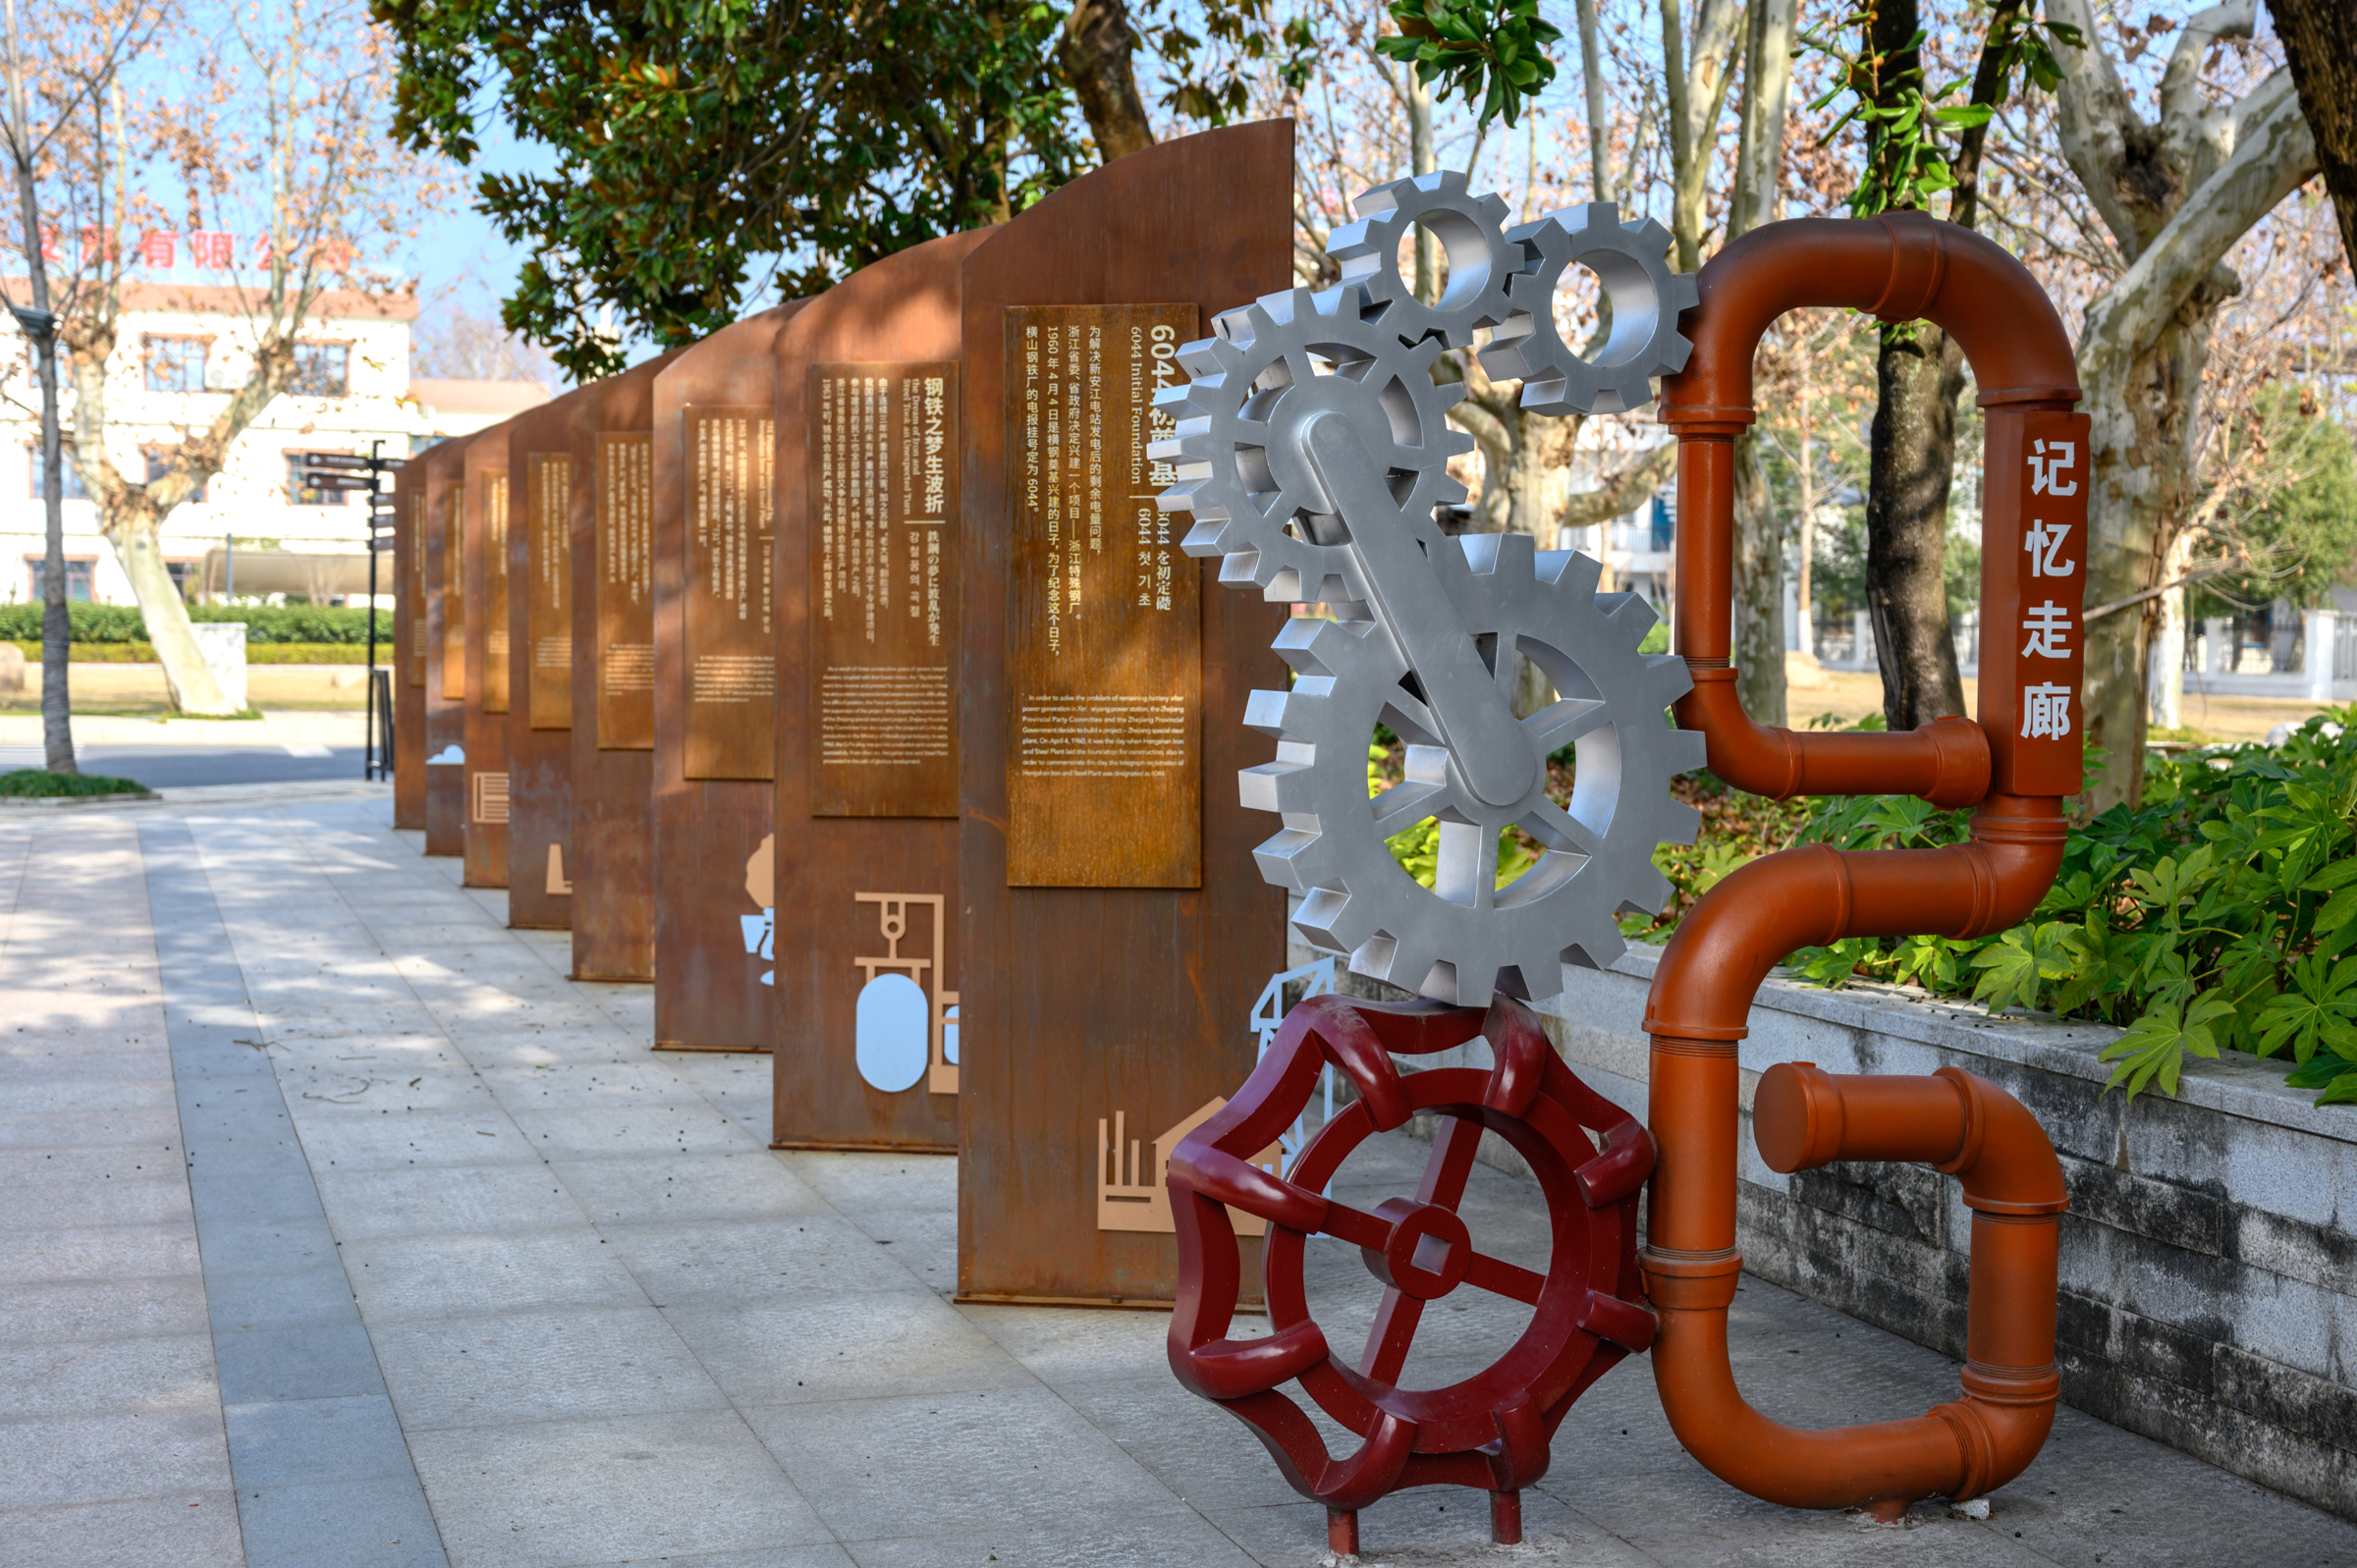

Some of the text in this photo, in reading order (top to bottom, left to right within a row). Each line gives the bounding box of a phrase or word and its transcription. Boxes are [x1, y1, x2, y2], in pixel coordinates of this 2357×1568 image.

[912, 426, 920, 437] of
[1131, 327, 1143, 485] 6044 Initial Foundation
[903, 440, 911, 492] Unexpected
[912, 459, 921, 475] and
[924, 377, 945, 514] 钢铁之梦生波折
[1138, 508, 1151, 545] 6044
[2020, 438, 2077, 740] 记忆走廊
